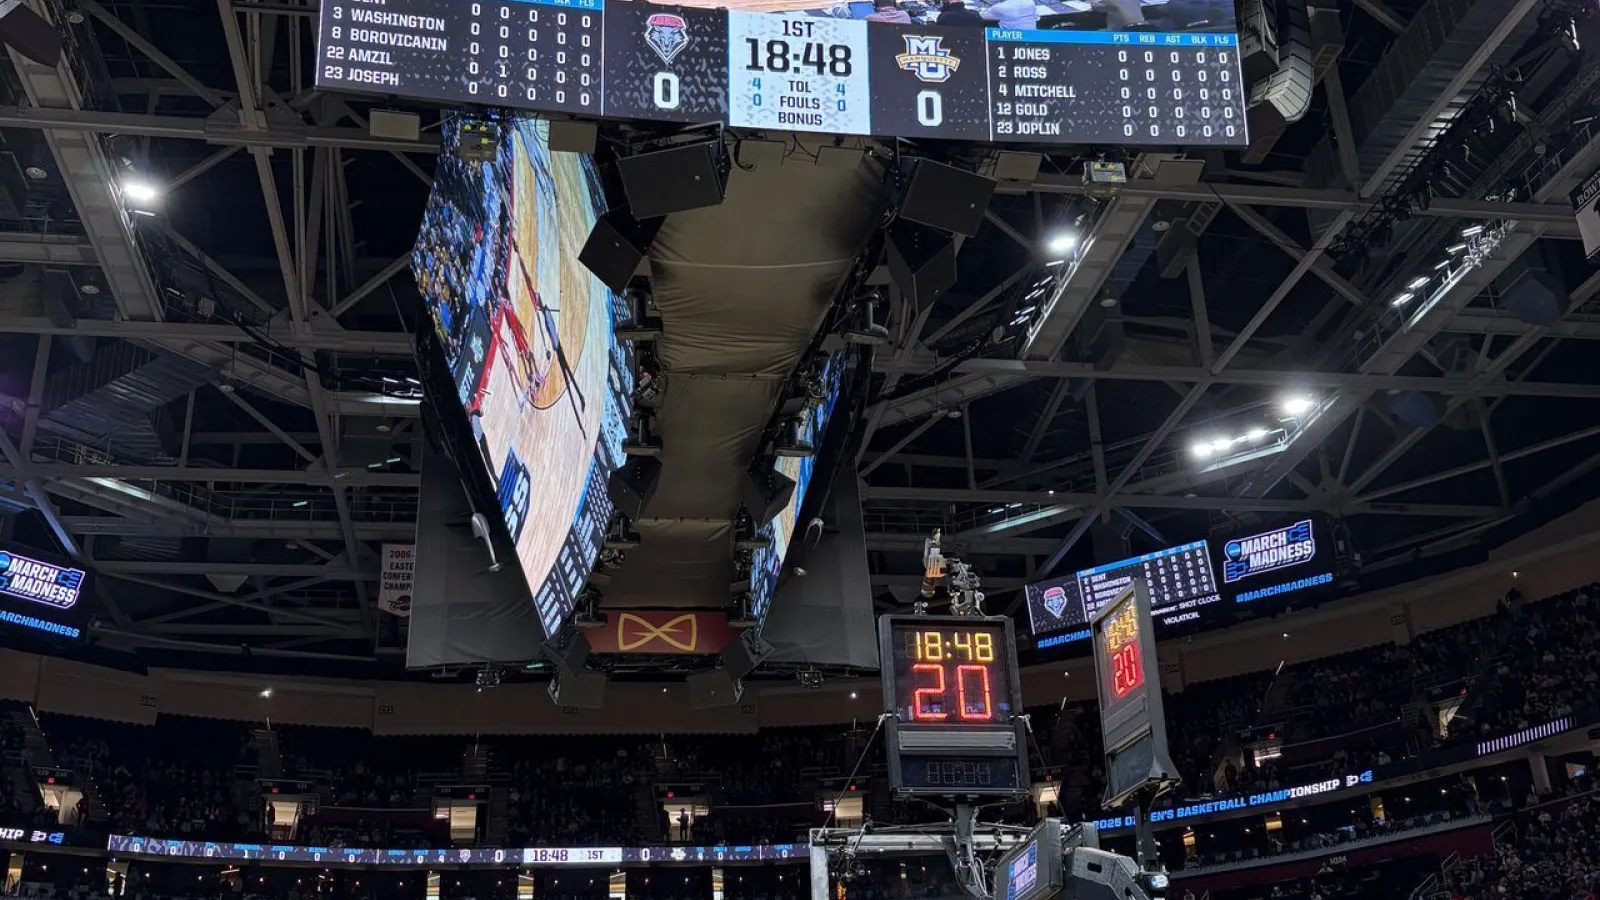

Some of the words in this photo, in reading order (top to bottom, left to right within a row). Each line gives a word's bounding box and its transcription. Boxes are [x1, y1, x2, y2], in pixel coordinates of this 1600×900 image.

[332, 6, 343, 19] 3
[351, 8, 446, 32] WASHINGTON
[470, 22, 481, 36] 0
[499, 25, 509, 39] 0
[528, 28, 538, 42] 0
[557, 31, 566, 45] 0
[581, 34, 591, 48] 0
[471, 3, 481, 16] 0
[500, 6, 510, 19] 0
[529, 9, 538, 23] 0
[557, 12, 567, 26] 0
[581, 15, 591, 28] 0
[782, 20, 815, 38] 1ST
[992, 30, 1022, 40] PLAYER
[1113, 35, 1130, 43] PTS
[1140, 35, 1156, 43] REB
[1165, 36, 1181, 44] AST
[1191, 36, 1206, 44] BLK
[1214, 36, 1229, 44] FLS
[331, 26, 342, 39] 8
[350, 28, 447, 52] BOROVICANIN
[469, 42, 480, 55] 0
[499, 45, 509, 58] 0
[528, 48, 537, 61] 0
[556, 51, 566, 64] 0
[580, 53, 591, 67] 0
[745, 37, 852, 78] 18:48
[997, 46, 1006, 59] 1
[1012, 47, 1051, 61] JONES
[1118, 50, 1127, 63] 0
[1144, 51, 1154, 63] 0
[1170, 51, 1180, 64] 0
[1196, 51, 1206, 64] 0
[1218, 51, 1228, 64] 0
[326, 45, 345, 60] 22
[348, 48, 394, 66] AMZIL
[469, 61, 479, 75] 0
[499, 64, 508, 78] 1
[526, 67, 537, 81] 0
[555, 70, 566, 84] 0
[580, 73, 590, 87] 0
[998, 65, 1007, 78] 2
[1013, 66, 1047, 79] ROSS
[1119, 68, 1129, 81] 0
[1145, 68, 1155, 82] 0
[1171, 69, 1181, 82] 0
[1197, 70, 1207, 82] 0
[1220, 70, 1230, 82] 0
[324, 65, 343, 79] 23
[346, 68, 400, 87] JOSEPH
[468, 81, 478, 95] 0
[498, 84, 507, 98] 0
[526, 87, 536, 101] 0
[555, 90, 566, 104] 0
[580, 92, 590, 106] 0
[653, 71, 680, 109] 0
[752, 77, 762, 90] 4
[788, 80, 812, 93] TOL
[836, 83, 846, 96] 4
[998, 83, 1008, 97] 4
[1014, 84, 1077, 98] MITCHELL
[1120, 86, 1130, 99] 0
[1147, 87, 1156, 100] 0
[1173, 87, 1183, 100] 0
[1199, 87, 1209, 101] 0
[1221, 88, 1232, 101] 0
[753, 93, 762, 107] 0
[780, 95, 820, 110] FOULS
[837, 99, 846, 112] 0
[917, 91, 943, 127] 0
[996, 102, 1012, 115] 12
[1015, 104, 1048, 117] GOLD
[1122, 105, 1131, 118] 0
[1148, 105, 1158, 118] 0
[1174, 106, 1184, 119] 0
[1200, 106, 1211, 119] 0
[1224, 106, 1234, 119] 0
[778, 111, 822, 126] BONUS
[996, 121, 1014, 134] 23
[1016, 122, 1060, 136] JOPLIN
[1123, 123, 1133, 137] 0
[1149, 124, 1160, 137] 0
[1176, 125, 1186, 138] 0
[1202, 125, 1213, 138] 0
[1225, 125, 1235, 138] 0
[1240, 531, 1288, 557] MARCH
[1249, 540, 1312, 568] MADNESS
[8, 558, 59, 583] MARCH
[389, 562, 415, 571] EASTE
[9, 574, 76, 603] MADNESS
[384, 581, 412, 591] CHAMP
[1236, 573, 1333, 602] #MARCHMADNESS
[1197, 594, 1221, 606] CLOCK
[0, 610, 80, 638] ARCHMADNESS
[916, 631, 994, 661] 18:48
[1038, 629, 1091, 648] #MARCHMA
[1113, 643, 1137, 694] 20
[913, 663, 993, 719] 20
[1150, 808, 1174, 822] EN'S
[1176, 796, 1247, 818] BASKETBALL
[1249, 778, 1340, 806] CHAMPIONSHIP
[495, 849, 504, 863] 0
[532, 849, 569, 862] 18:48
[587, 850, 604, 860] 1ST
[641, 848, 651, 862] 0
